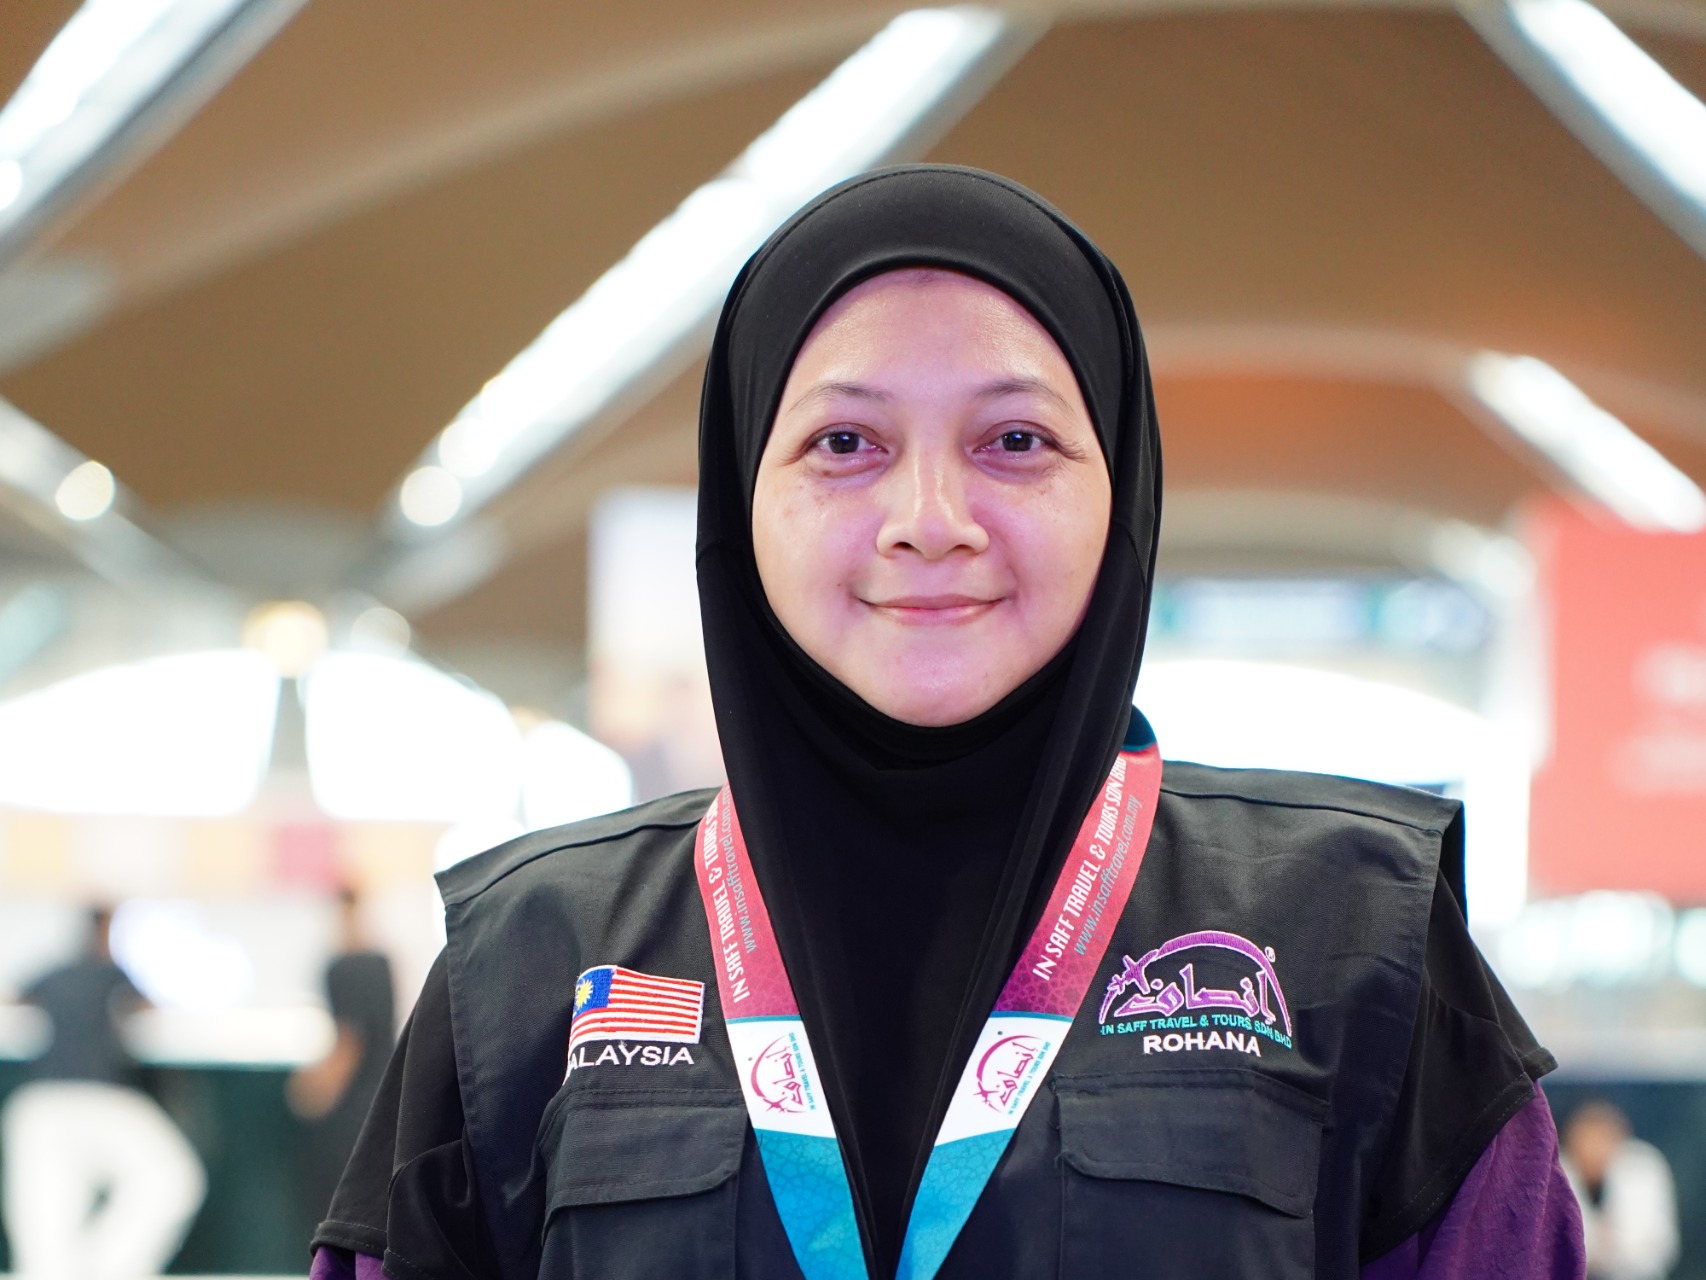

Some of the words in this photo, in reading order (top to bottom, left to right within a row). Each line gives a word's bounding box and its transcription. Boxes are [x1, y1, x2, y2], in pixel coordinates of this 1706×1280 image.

[1105, 774, 1124, 807] SDN
[1094, 801, 1119, 846] TOURS
[703, 819, 719, 870] TOURS
[1089, 843, 1106, 861] &
[708, 866, 723, 884] &
[1063, 859, 1101, 918] TRAVEL
[1074, 794, 1143, 956] www.insafftravel.com.my
[712, 879, 736, 945] TRAVEL
[1045, 914, 1075, 959] SAFF
[723, 941, 744, 981] SAFF
[1032, 954, 1057, 981] IN
[730, 978, 750, 1003] IN
[1100, 1023, 1114, 1036] IN
[1117, 1020, 1147, 1035] SAFF
[1150, 1015, 1197, 1030] TRAVEL
[1200, 1014, 1209, 1026] &
[1211, 1014, 1252, 1031] TOURS
[1254, 1019, 1275, 1041] SDN
[1274, 1031, 1292, 1050] BHD
[1143, 1031, 1262, 1057] ROHANA
